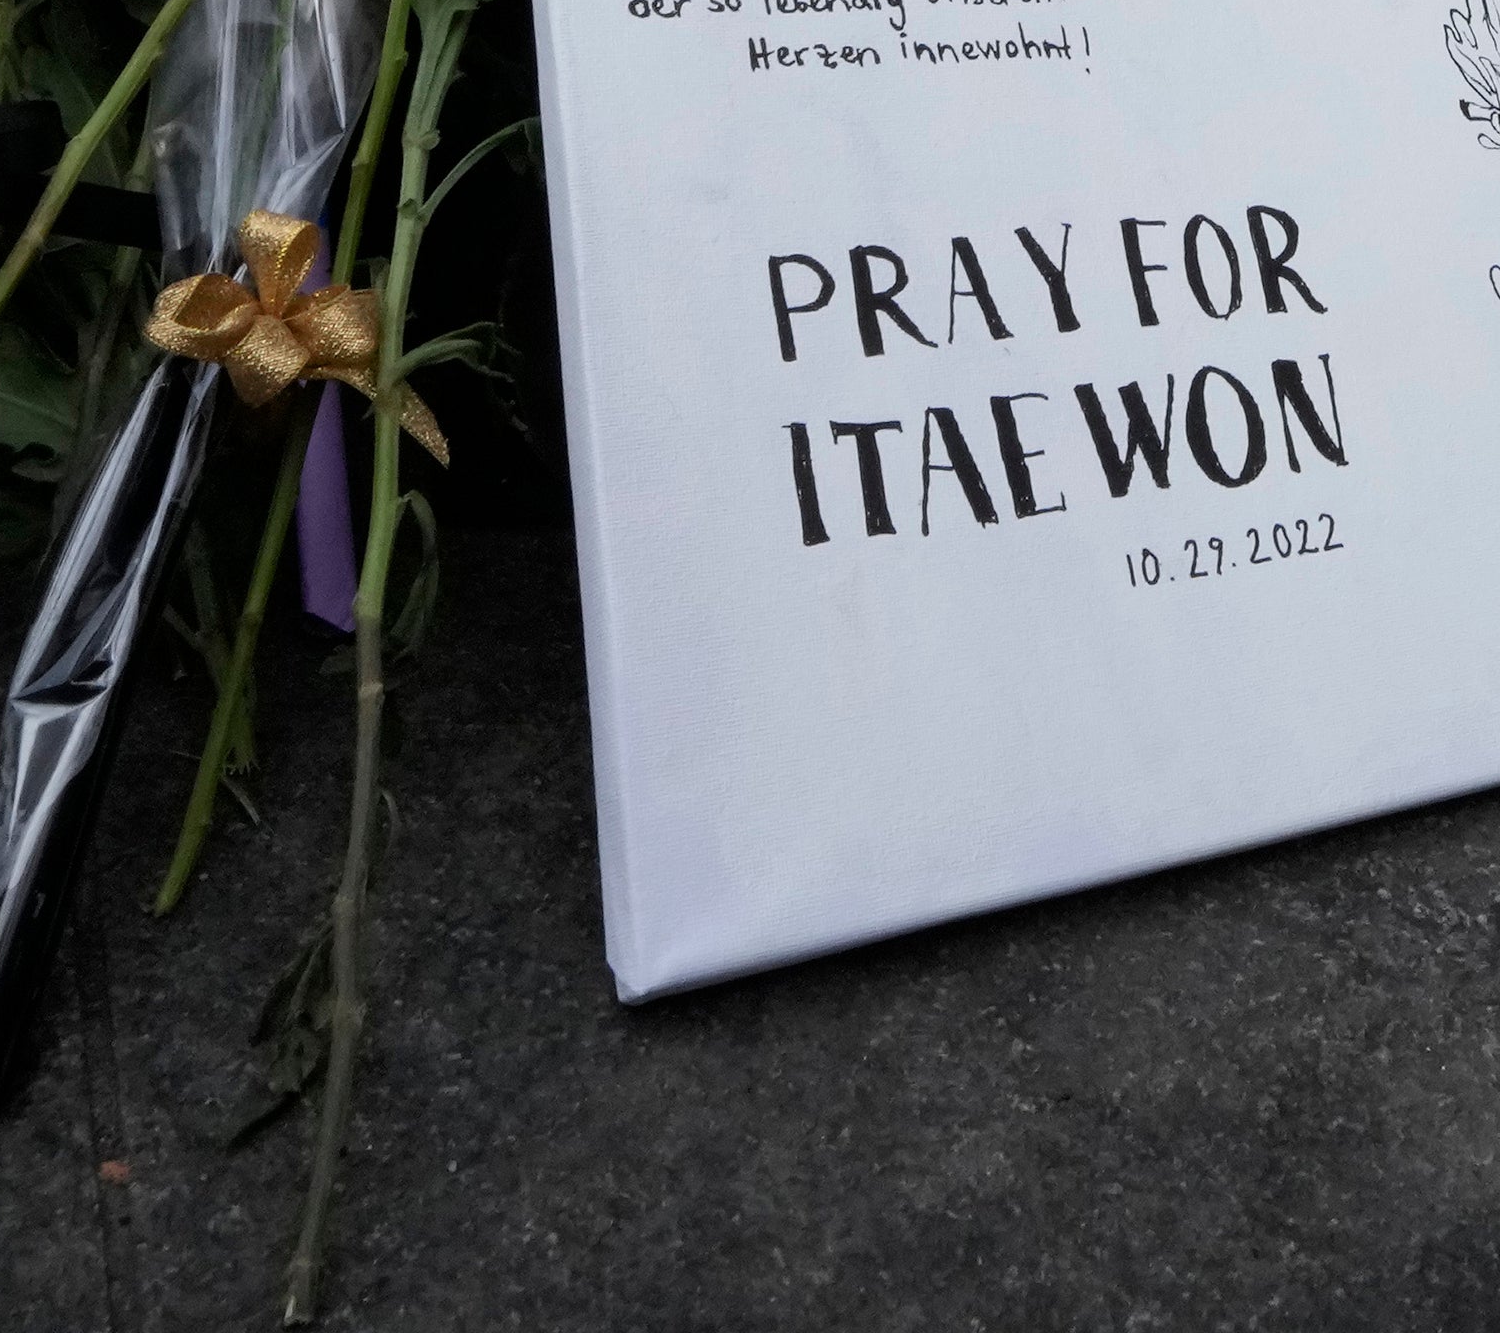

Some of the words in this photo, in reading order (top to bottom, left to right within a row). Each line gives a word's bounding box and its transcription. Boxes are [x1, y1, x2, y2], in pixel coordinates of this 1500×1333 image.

[748, 37, 881, 72] Herzen
[900, 22, 1090, 74] innewohnt!
[769, 224, 1080, 362] PRAY
[1120, 206, 1327, 326] FOR
[783, 354, 1349, 546] ITAEWON
[1126, 513, 1344, 587] 10.29.2022
